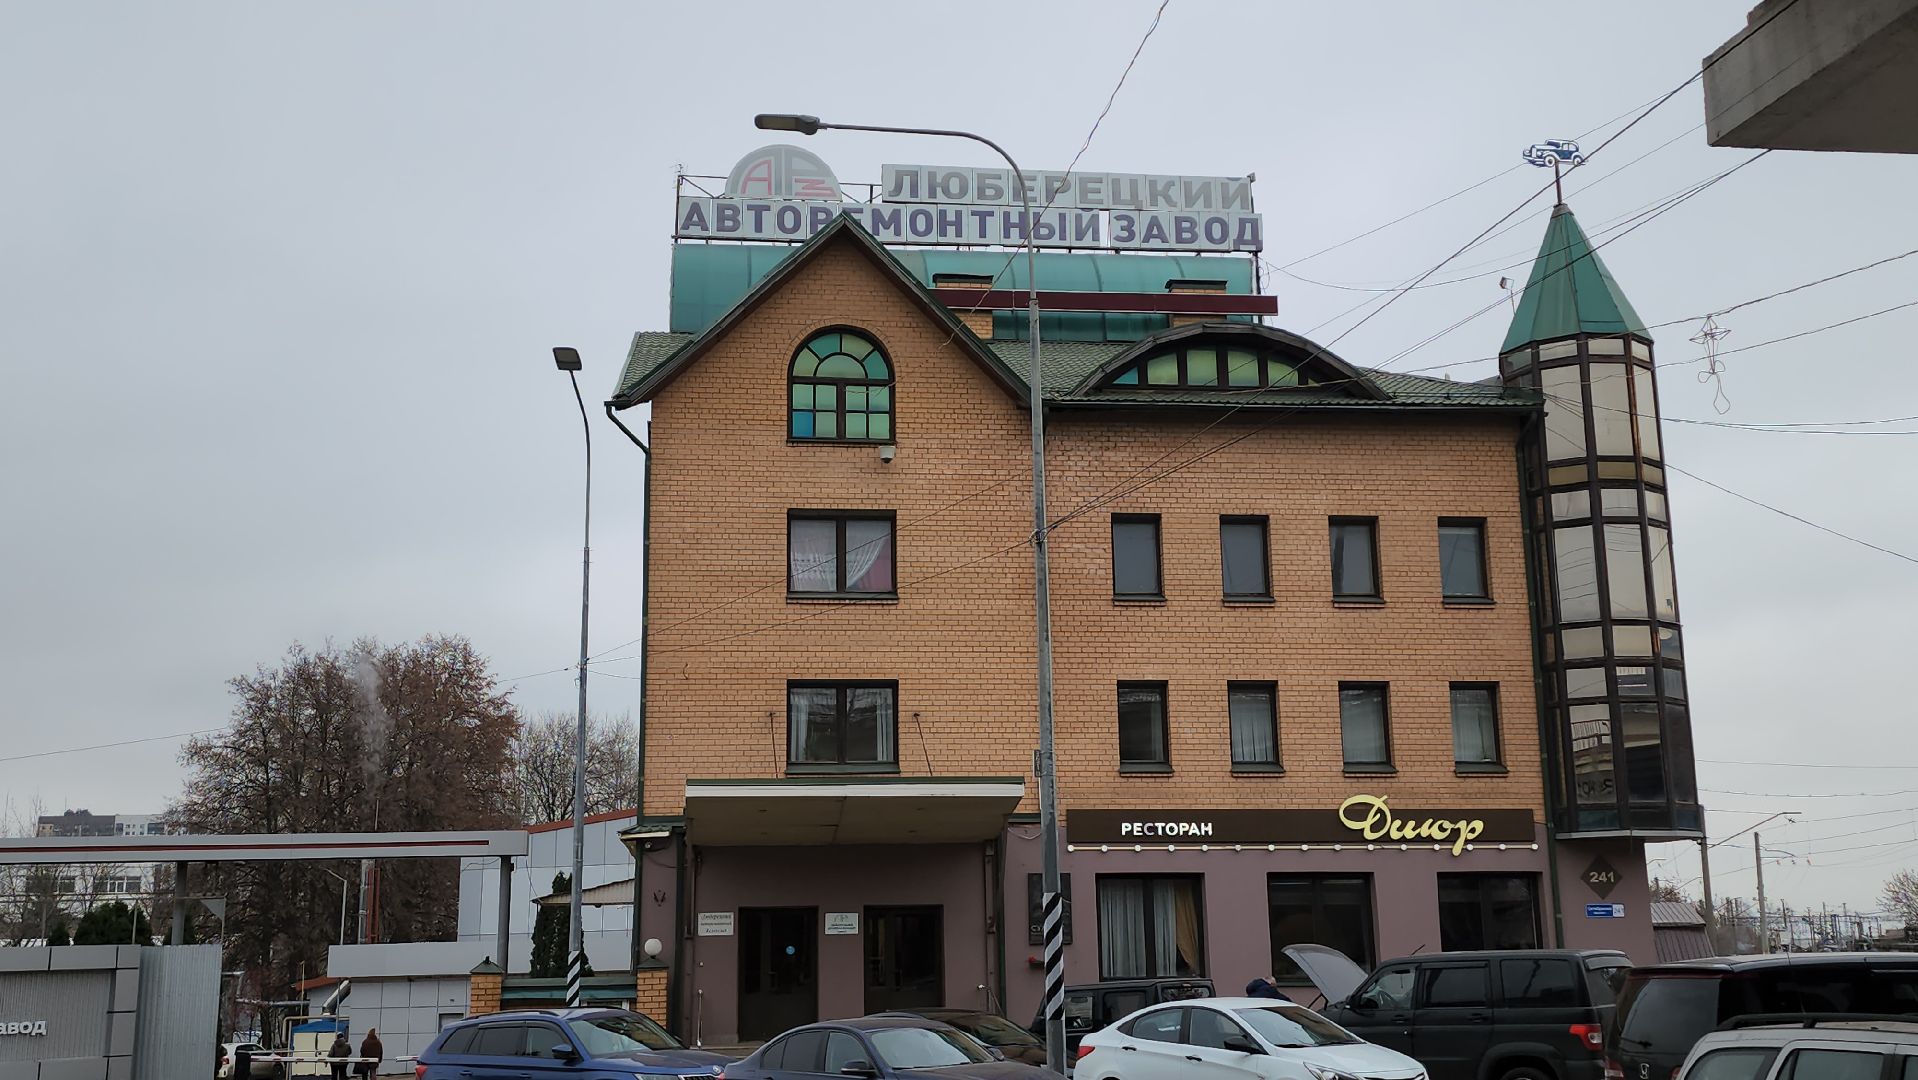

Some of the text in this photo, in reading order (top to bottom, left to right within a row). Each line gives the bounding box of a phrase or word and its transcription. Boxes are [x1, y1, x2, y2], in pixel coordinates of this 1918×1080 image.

[888, 169, 1250, 210] ЛЮБЕРЕЦКИЙ
[1113, 214, 1263, 250] ЗАВОД
[1121, 822, 1213, 836] РЕСТОРАН
[1590, 871, 1615, 883] 241
